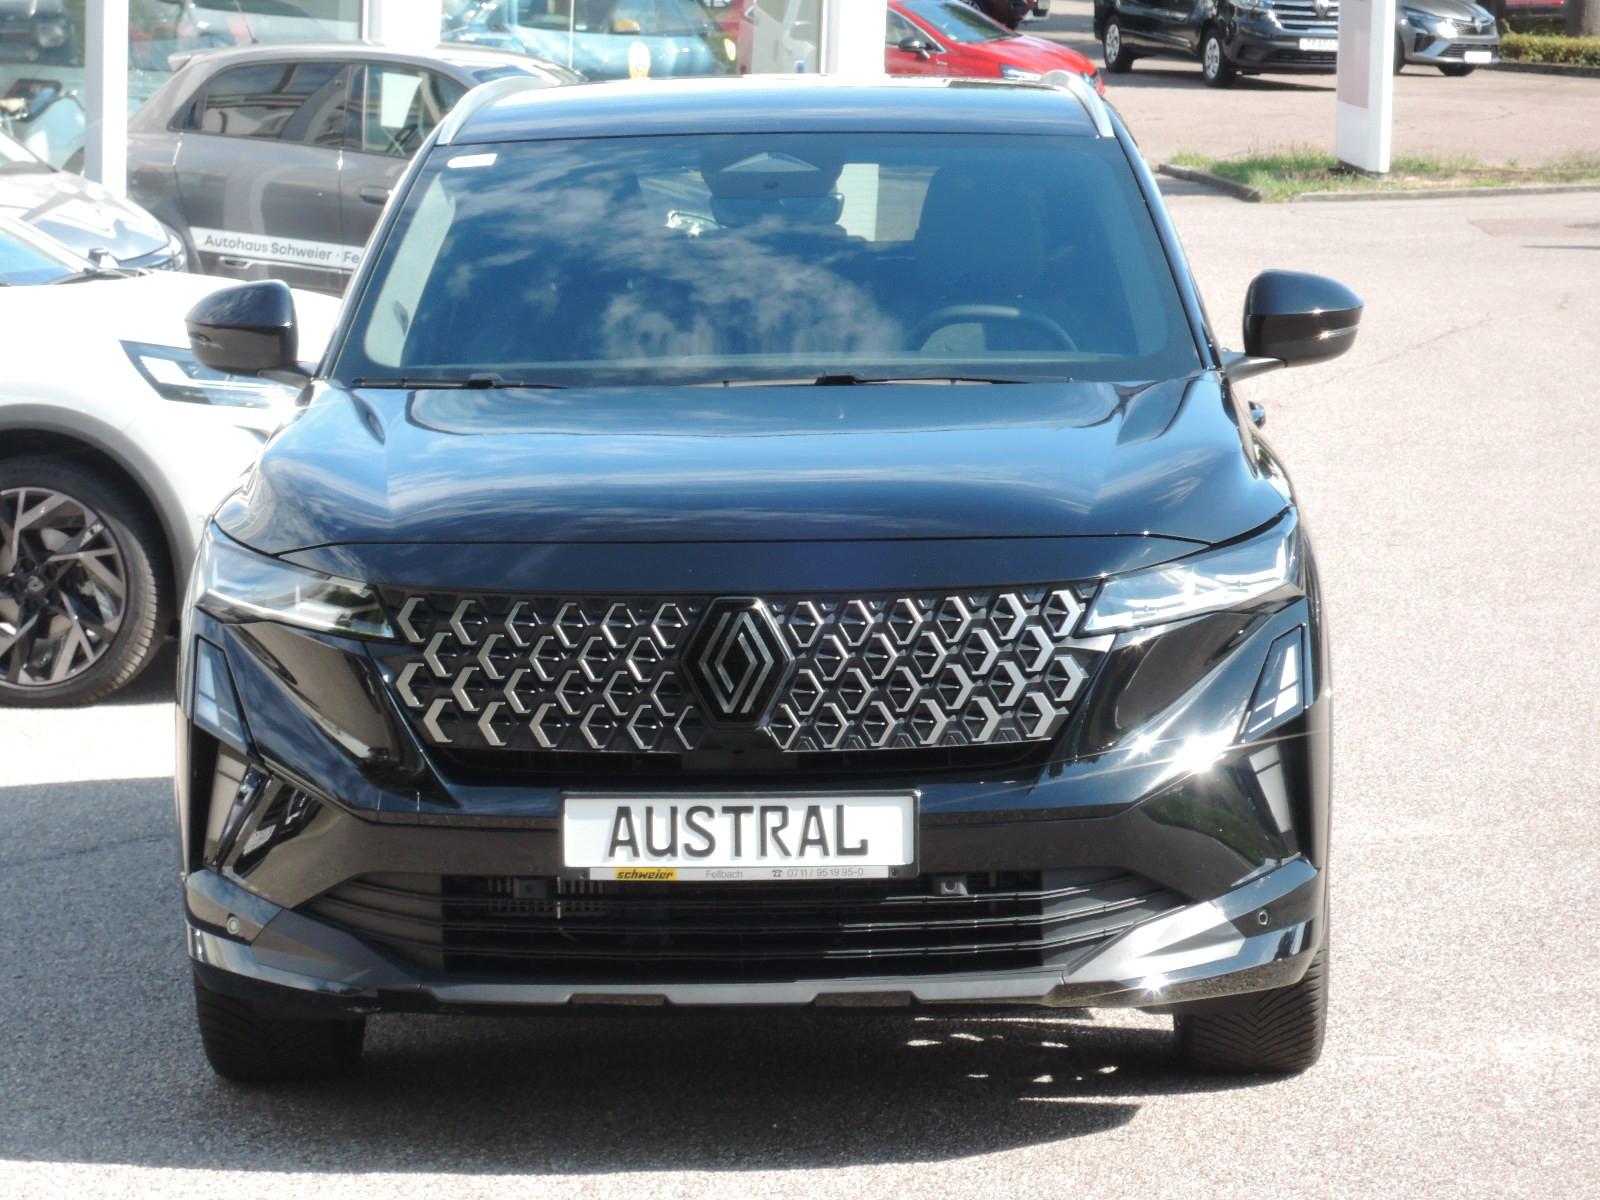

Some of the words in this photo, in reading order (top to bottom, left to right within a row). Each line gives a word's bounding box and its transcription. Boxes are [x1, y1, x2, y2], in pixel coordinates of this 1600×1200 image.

[204, 234, 269, 252] Autohaus
[271, 242, 333, 260] Schweier
[607, 804, 869, 858] AUSTRAL
[616, 869, 674, 880] schweier
